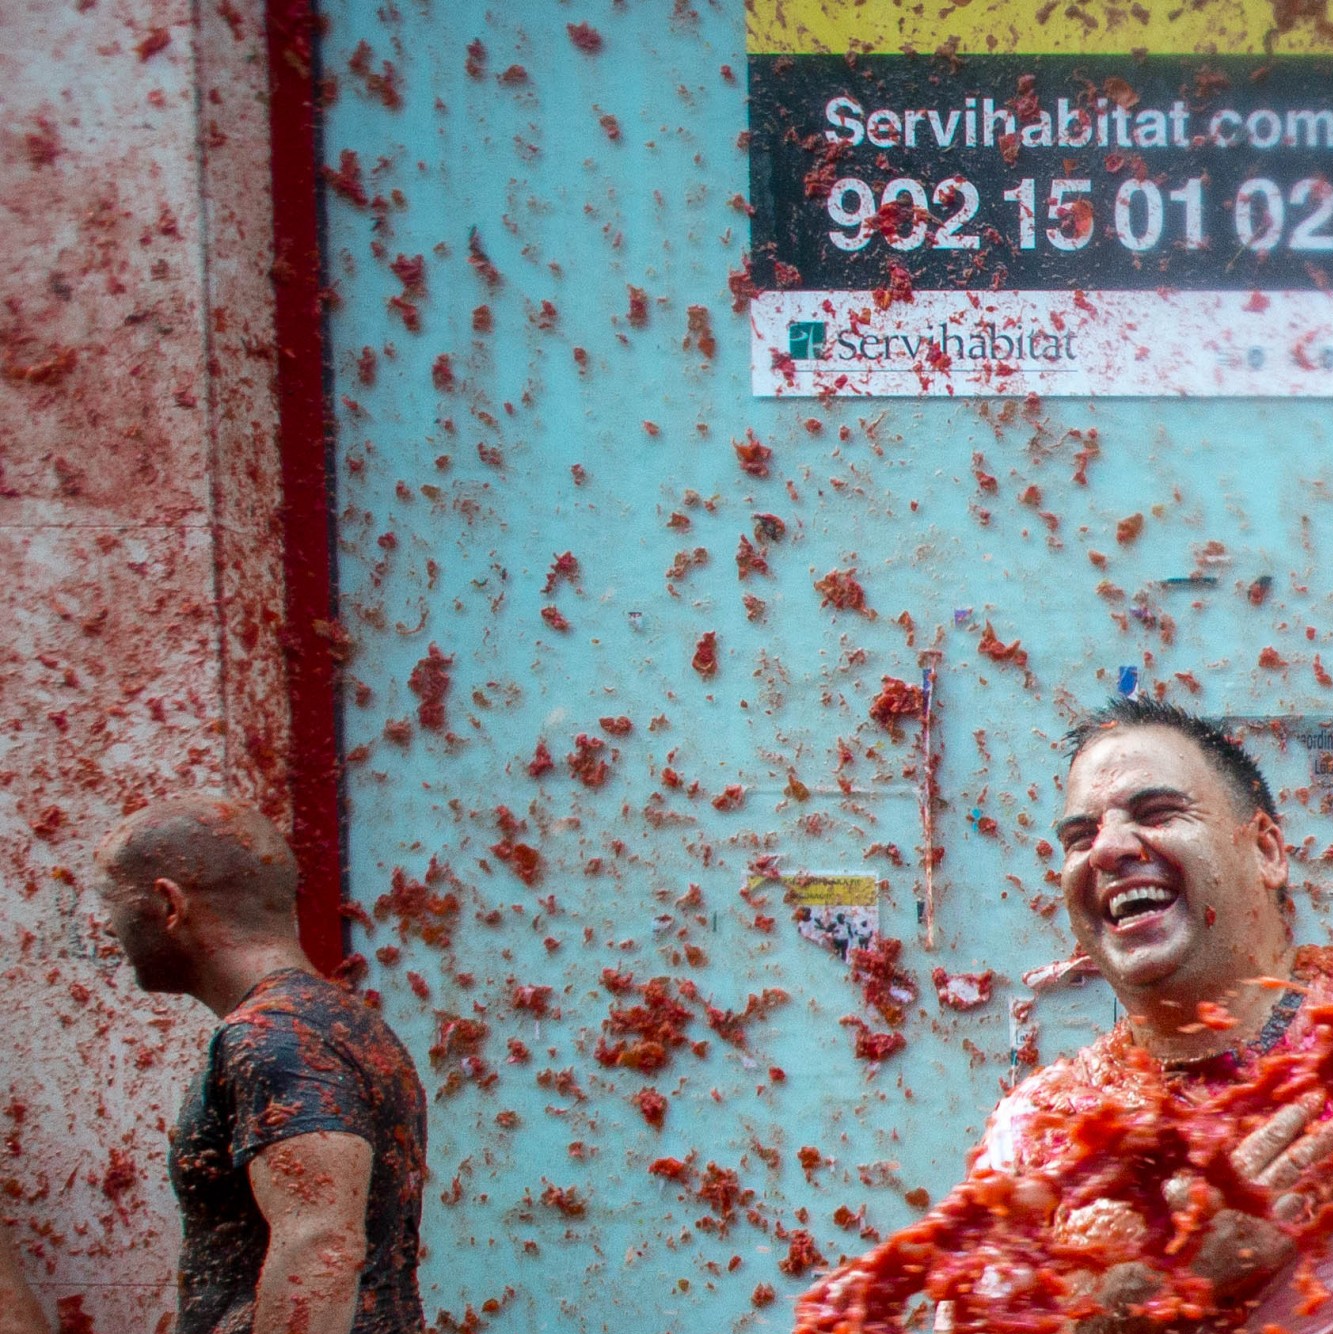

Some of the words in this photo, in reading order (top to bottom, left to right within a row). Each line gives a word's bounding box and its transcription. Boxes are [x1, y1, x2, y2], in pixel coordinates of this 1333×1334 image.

[826, 178, 980, 251] 902
[1002, 178, 1093, 251] 15
[1114, 178, 1204, 251] 01
[837, 323, 1078, 361] Servihabitat
